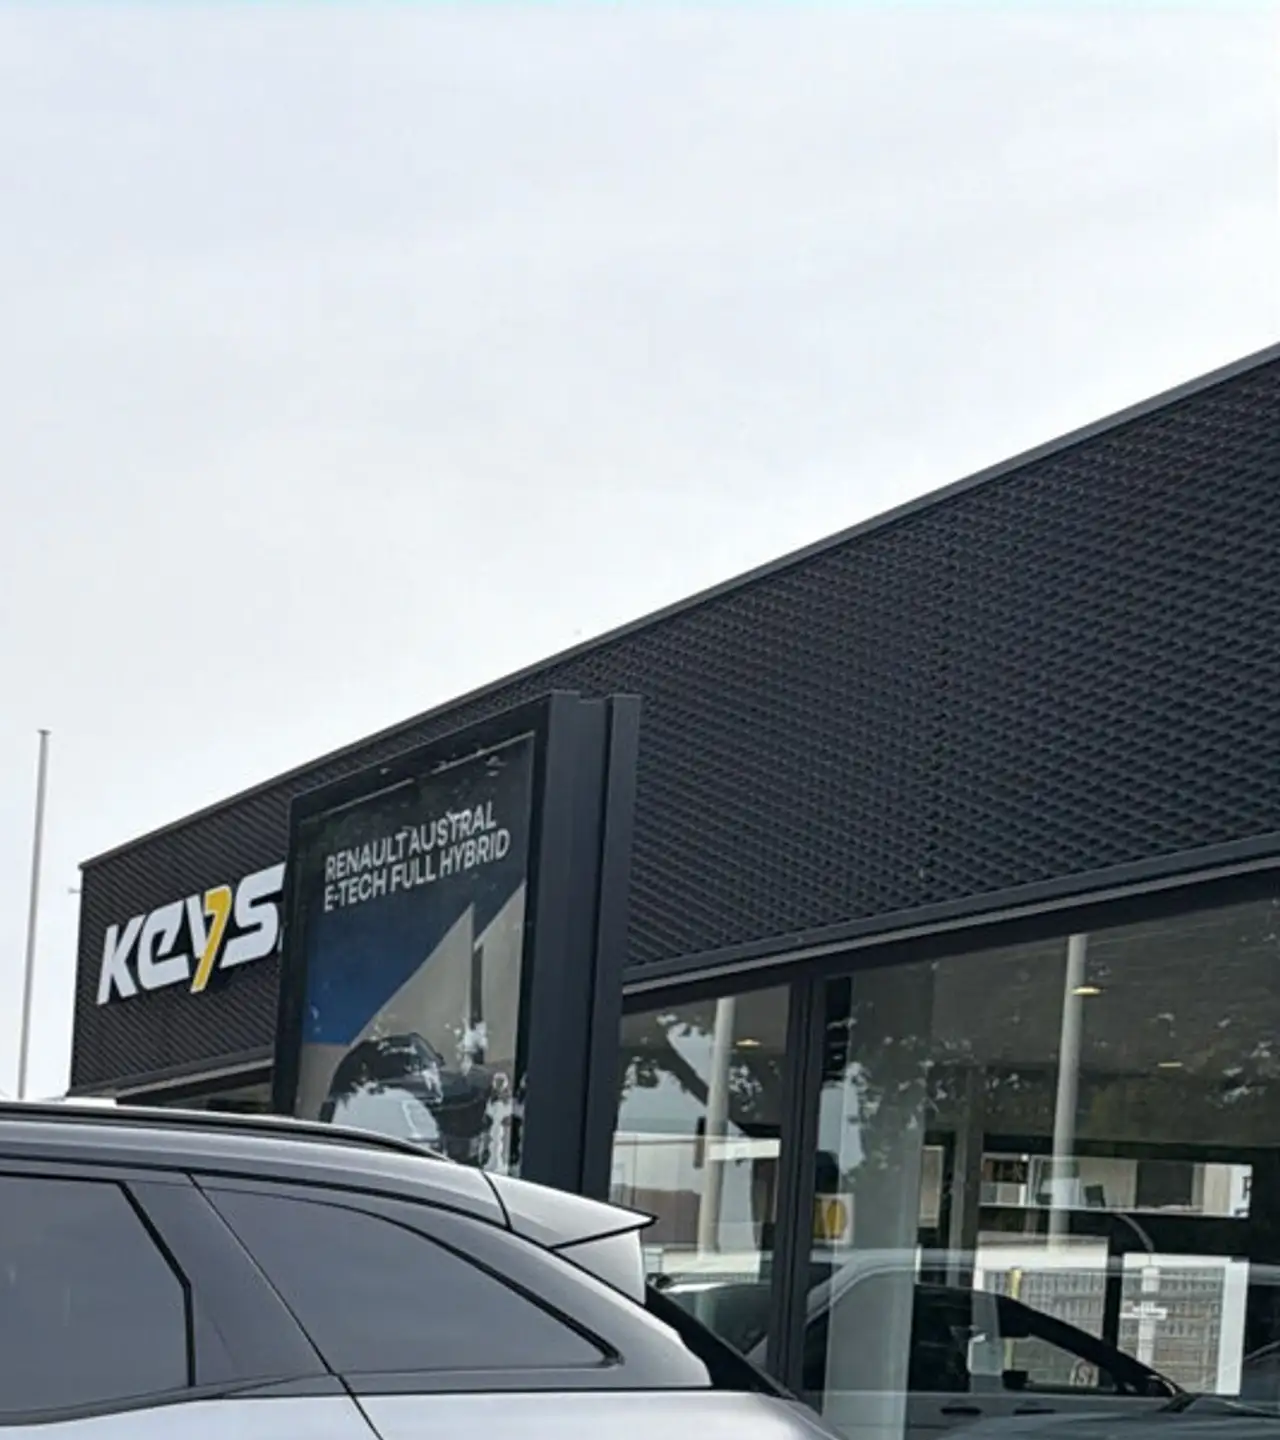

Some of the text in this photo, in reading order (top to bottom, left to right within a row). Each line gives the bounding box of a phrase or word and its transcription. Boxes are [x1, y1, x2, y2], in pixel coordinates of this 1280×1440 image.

[323, 828, 511, 913] E-TECH FULL HYBRID
[324, 801, 497, 883] RENAULT AUSTRAL
